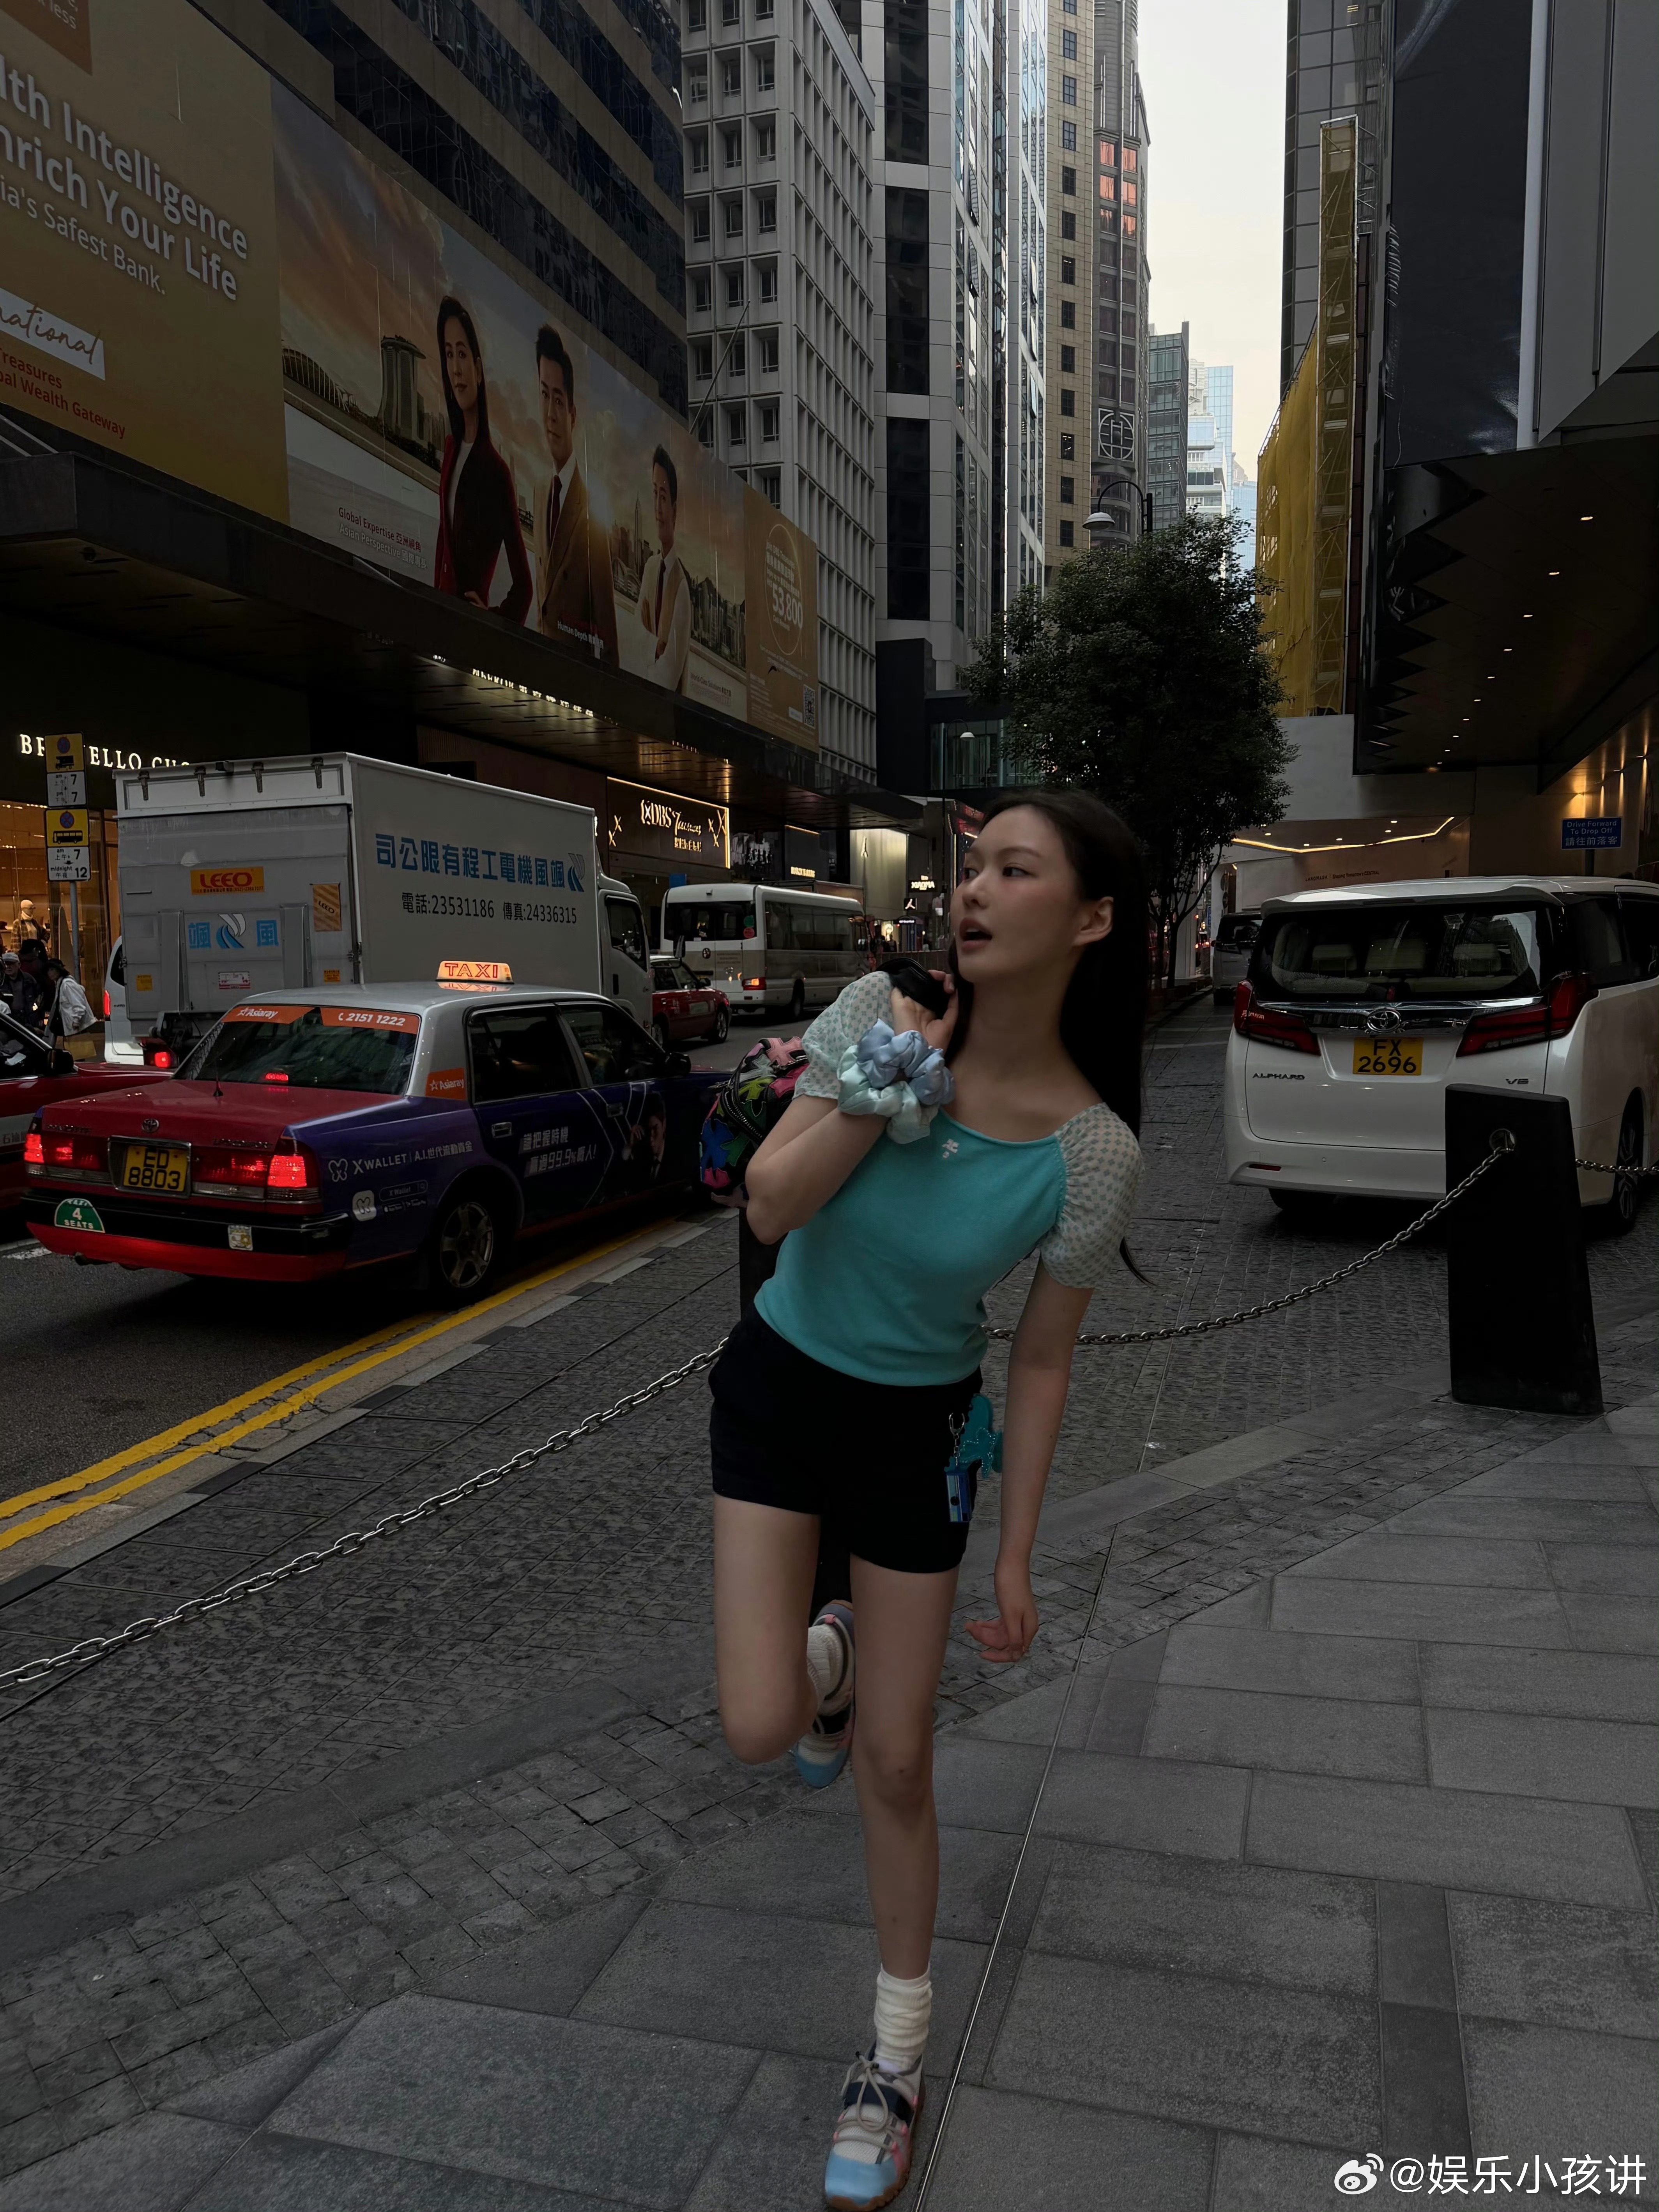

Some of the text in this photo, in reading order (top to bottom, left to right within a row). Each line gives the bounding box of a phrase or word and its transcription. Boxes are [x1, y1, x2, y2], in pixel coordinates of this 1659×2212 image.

[64, 101, 247, 259] Intelligence
[97, 179, 175, 260] Your
[185, 237, 237, 300] Life
[44, 203, 108, 261] Safest
[113, 244, 165, 295] Bank.
[0, 303, 101, 365] ational
[0, 348, 62, 389] reasures
[21, 377, 69, 411] Wealth
[73, 402, 125, 439] Gateway
[339, 507, 421, 553] Global Expertise 亞洲視角
[340, 523, 359, 541] Asian
[361, 532, 400, 558] Perspective
[773, 583, 803, 629] 53,800
[71, 774, 76, 785] 7
[72, 792, 78, 802] 7
[1565, 836, 1617, 846] 請往前落客
[74, 849, 80, 859] 7
[75, 867, 87, 878] 12
[200, 872, 252, 888] LEEO
[402, 892, 494, 918] 電話:23531186
[445, 963, 498, 978] TAXI
[245, 1009, 278, 1019] Asiaray
[346, 1013, 406, 1026] 2151 1222
[1374, 1039, 1401, 1056] FX
[1358, 1056, 1416, 1073] 2696
[439, 1079, 464, 1090] Asiaray
[145, 1150, 170, 1169] ED
[352, 1159, 364, 1175] X
[364, 1154, 407, 1170] WALLET
[129, 1167, 180, 1189] 8803
[72, 1208, 82, 1220] 4
[64, 1219, 94, 1229] SEATS
